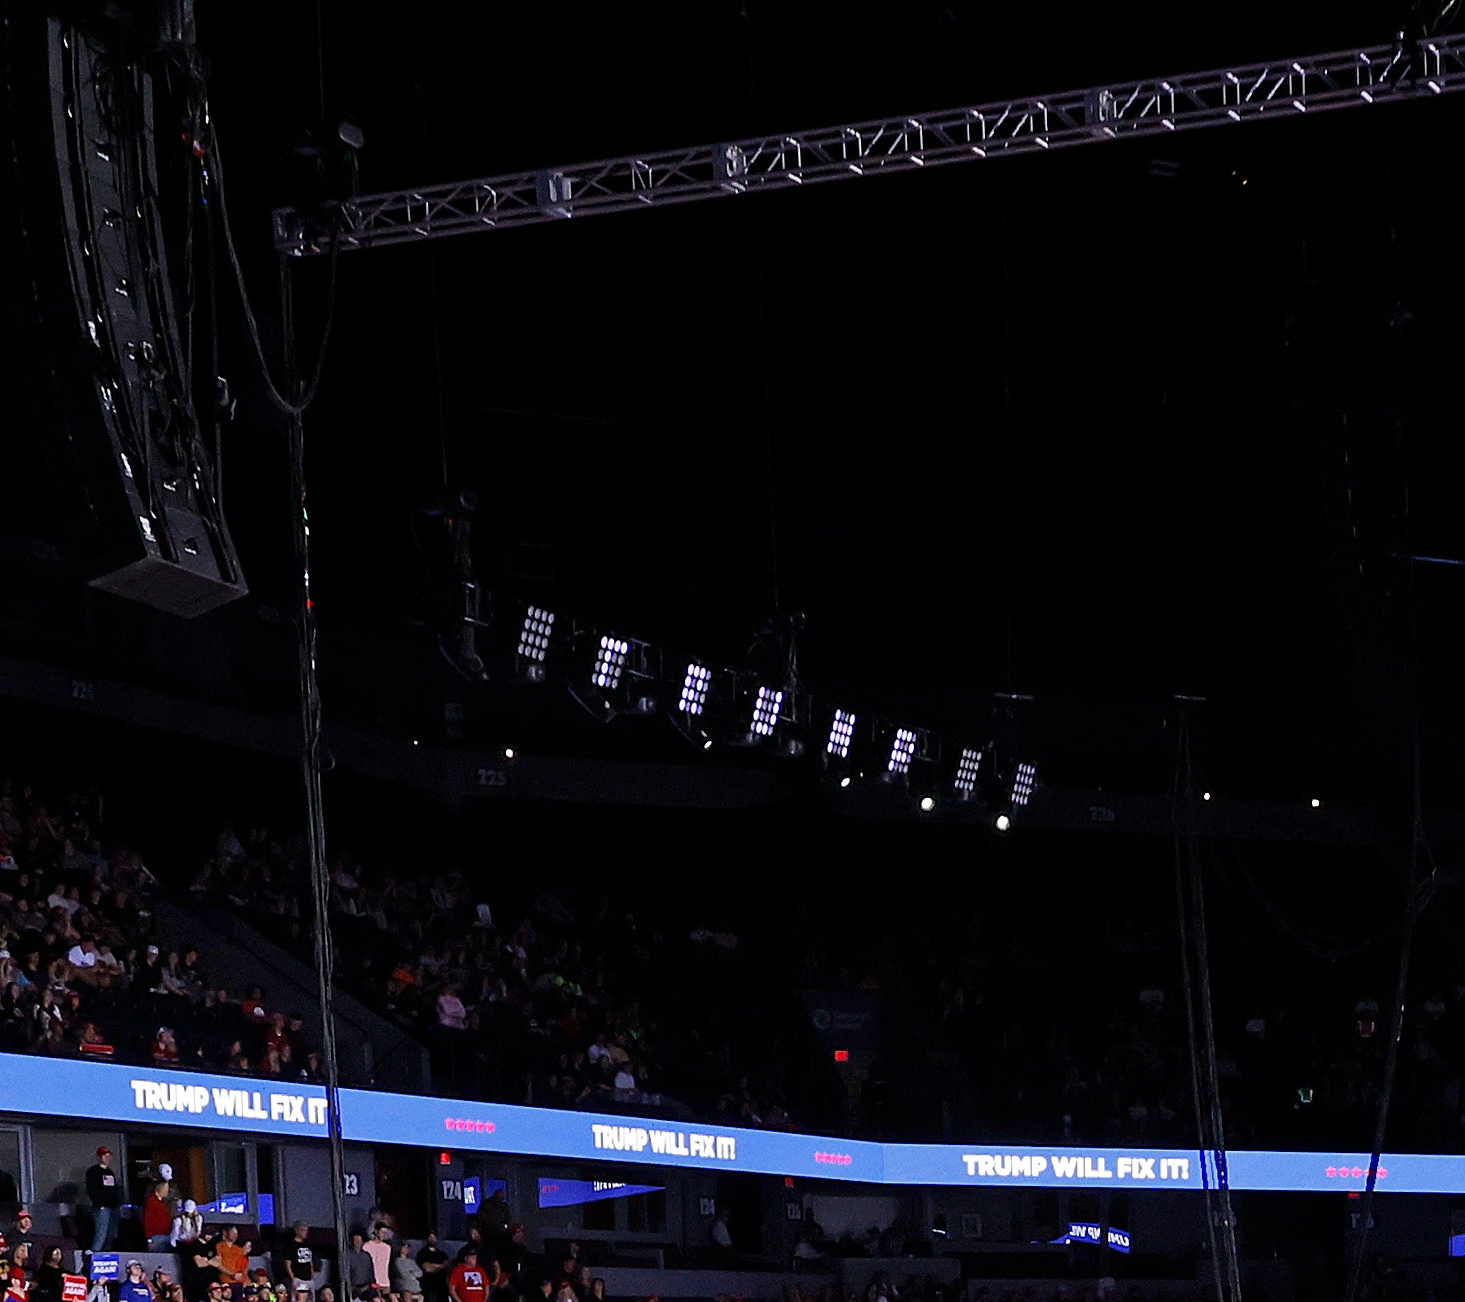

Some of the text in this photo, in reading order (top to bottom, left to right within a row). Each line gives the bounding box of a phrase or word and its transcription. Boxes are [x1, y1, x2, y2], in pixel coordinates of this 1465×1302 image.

[131, 1080, 210, 1114] TRUMP
[211, 1088, 268, 1120] WILL
[270, 1093, 306, 1122] FIX
[592, 1124, 736, 1160] TRUMP WILL FIX IT!
[963, 1155, 1190, 1181] TRUMP WILL FIX IT!
[343, 1174, 359, 1196] 23
[441, 1180, 462, 1201] 124
